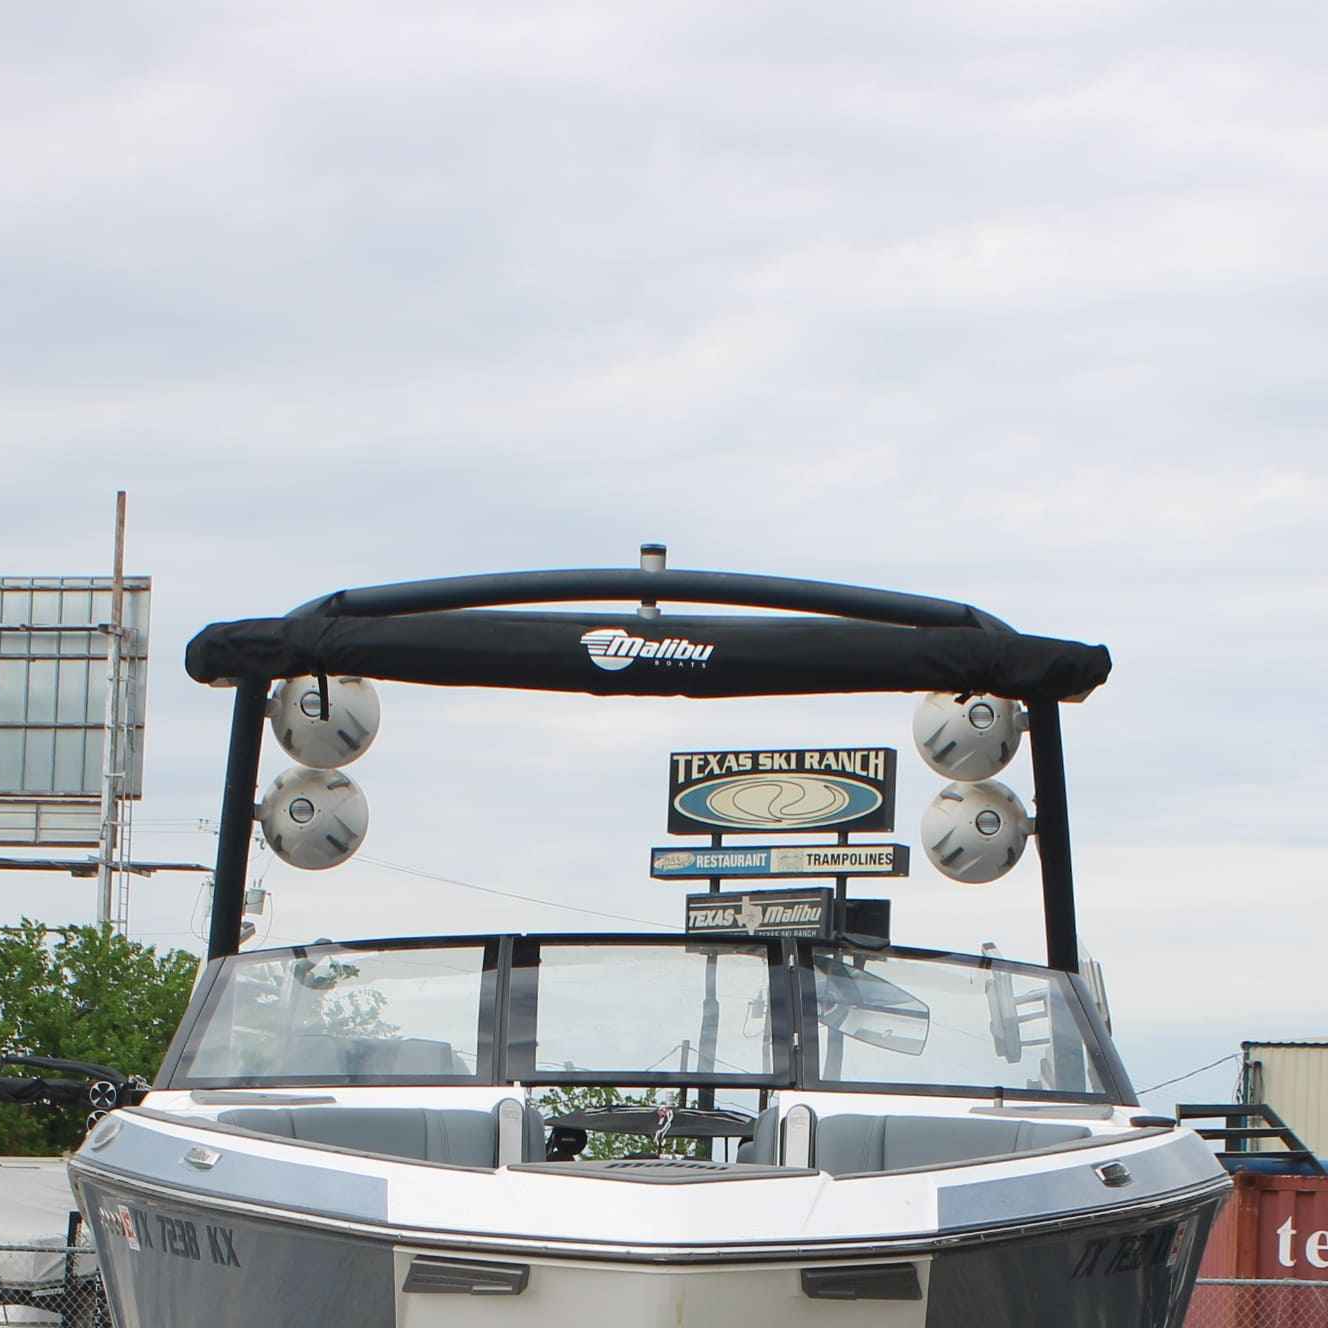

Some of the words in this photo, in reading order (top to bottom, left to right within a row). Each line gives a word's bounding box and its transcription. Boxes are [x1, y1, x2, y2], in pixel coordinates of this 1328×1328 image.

[606, 635, 714, 661] Malibu
[654, 660, 708, 669] BOATS
[673, 753, 753, 784] TEXAS
[758, 751, 797, 771] SKI
[804, 750, 886, 781] RANCH
[696, 853, 768, 868] RESTAURANT
[806, 852, 893, 866] TRAMPOLINES
[688, 908, 736, 928] TEXAS
[764, 904, 822, 924] Malibu
[206, 1224, 242, 1268] KX
